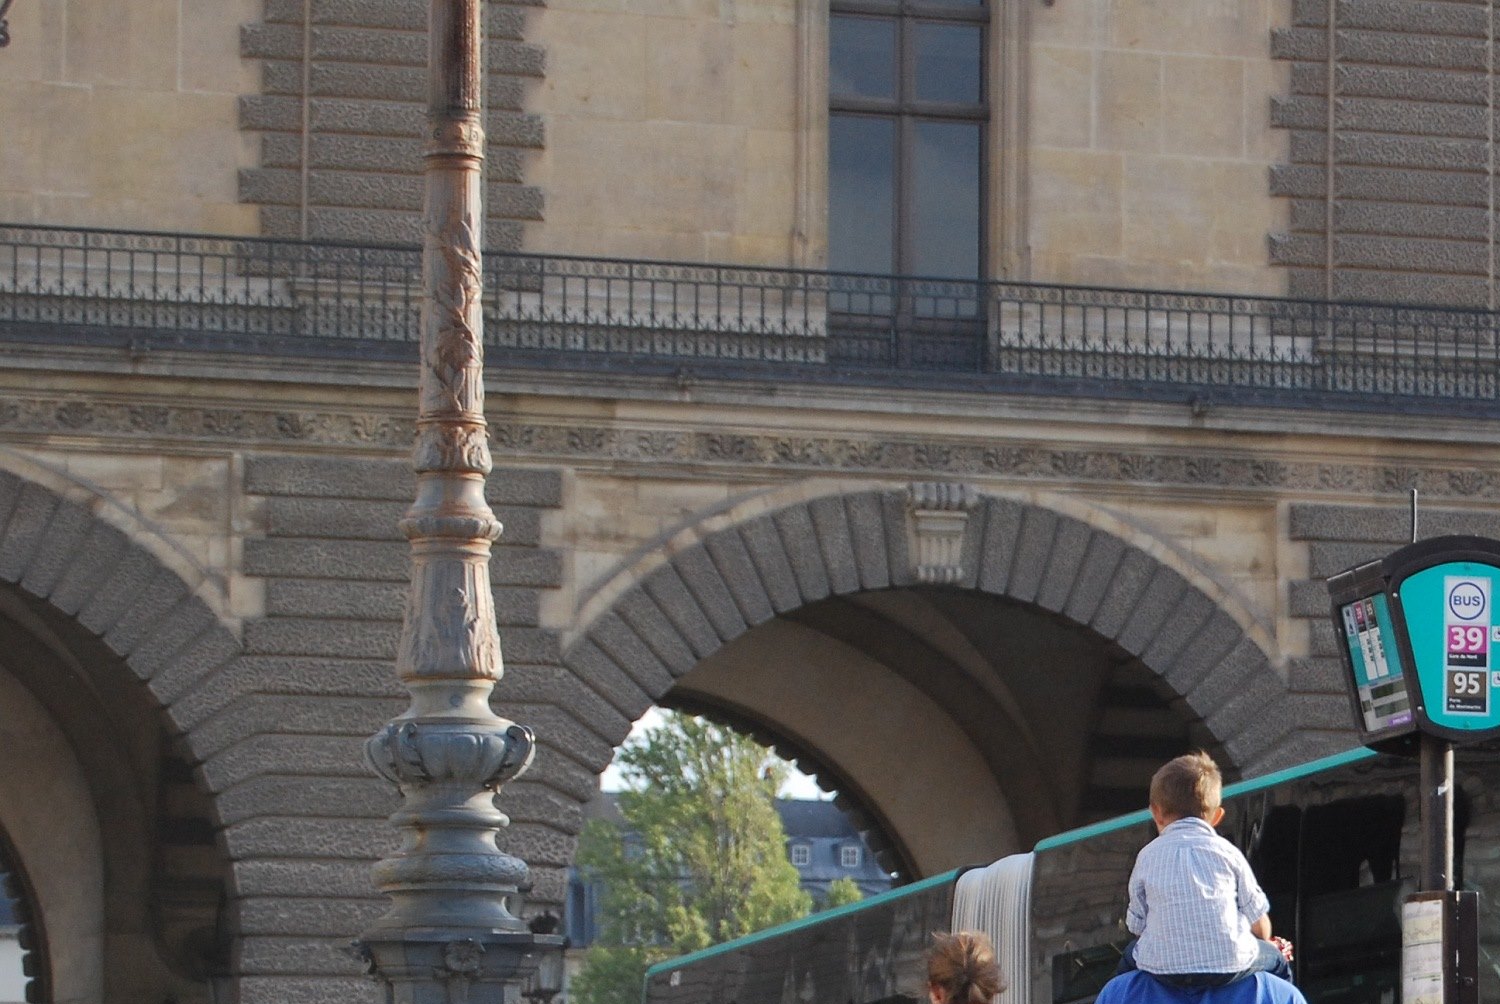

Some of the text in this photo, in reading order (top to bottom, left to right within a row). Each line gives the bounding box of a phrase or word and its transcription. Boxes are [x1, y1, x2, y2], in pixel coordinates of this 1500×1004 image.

[1453, 595, 1481, 606] BUS
[1450, 626, 1483, 651] 39
[1453, 672, 1480, 694] 95
